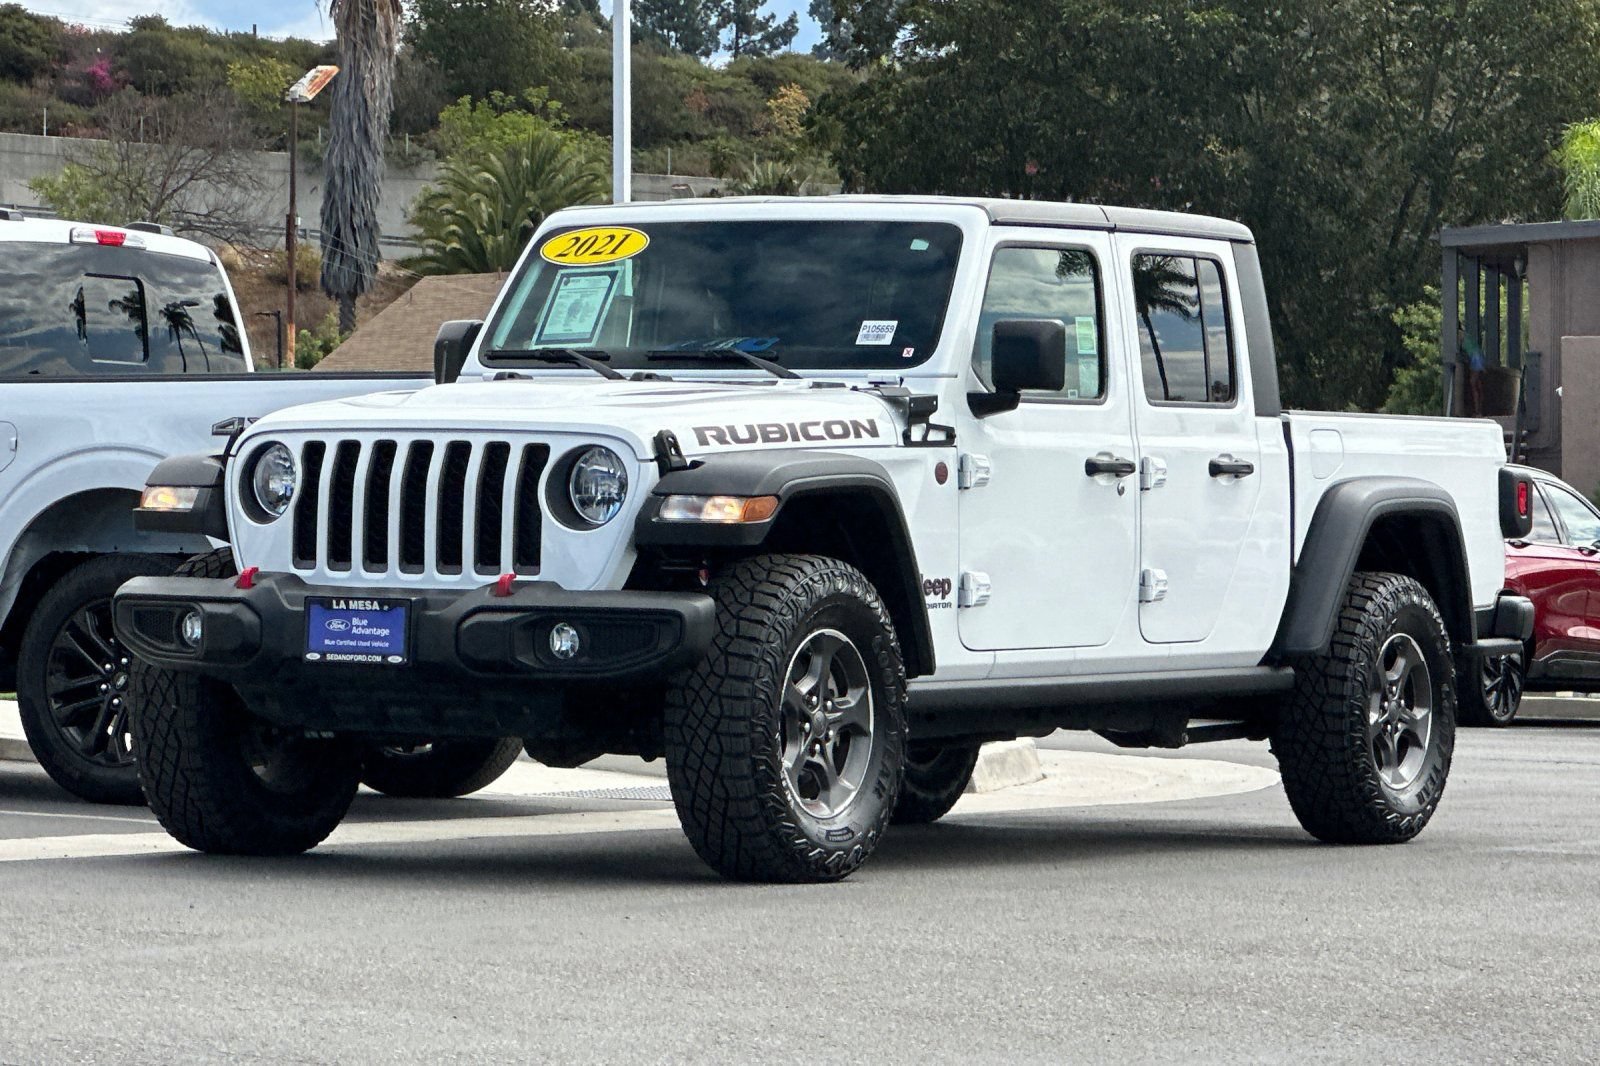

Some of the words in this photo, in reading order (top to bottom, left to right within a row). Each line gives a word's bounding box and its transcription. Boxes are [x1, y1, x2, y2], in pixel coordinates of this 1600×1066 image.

[554, 233, 632, 258] 2021
[861, 324, 895, 334] P105659
[692, 419, 880, 447] RUBICON
[332, 600, 347, 609] LA
[349, 601, 380, 611] MESA
[352, 617, 368, 626] Blue
[352, 627, 390, 637] Advantage
[326, 654, 382, 662] SEDANOFORD.COM
